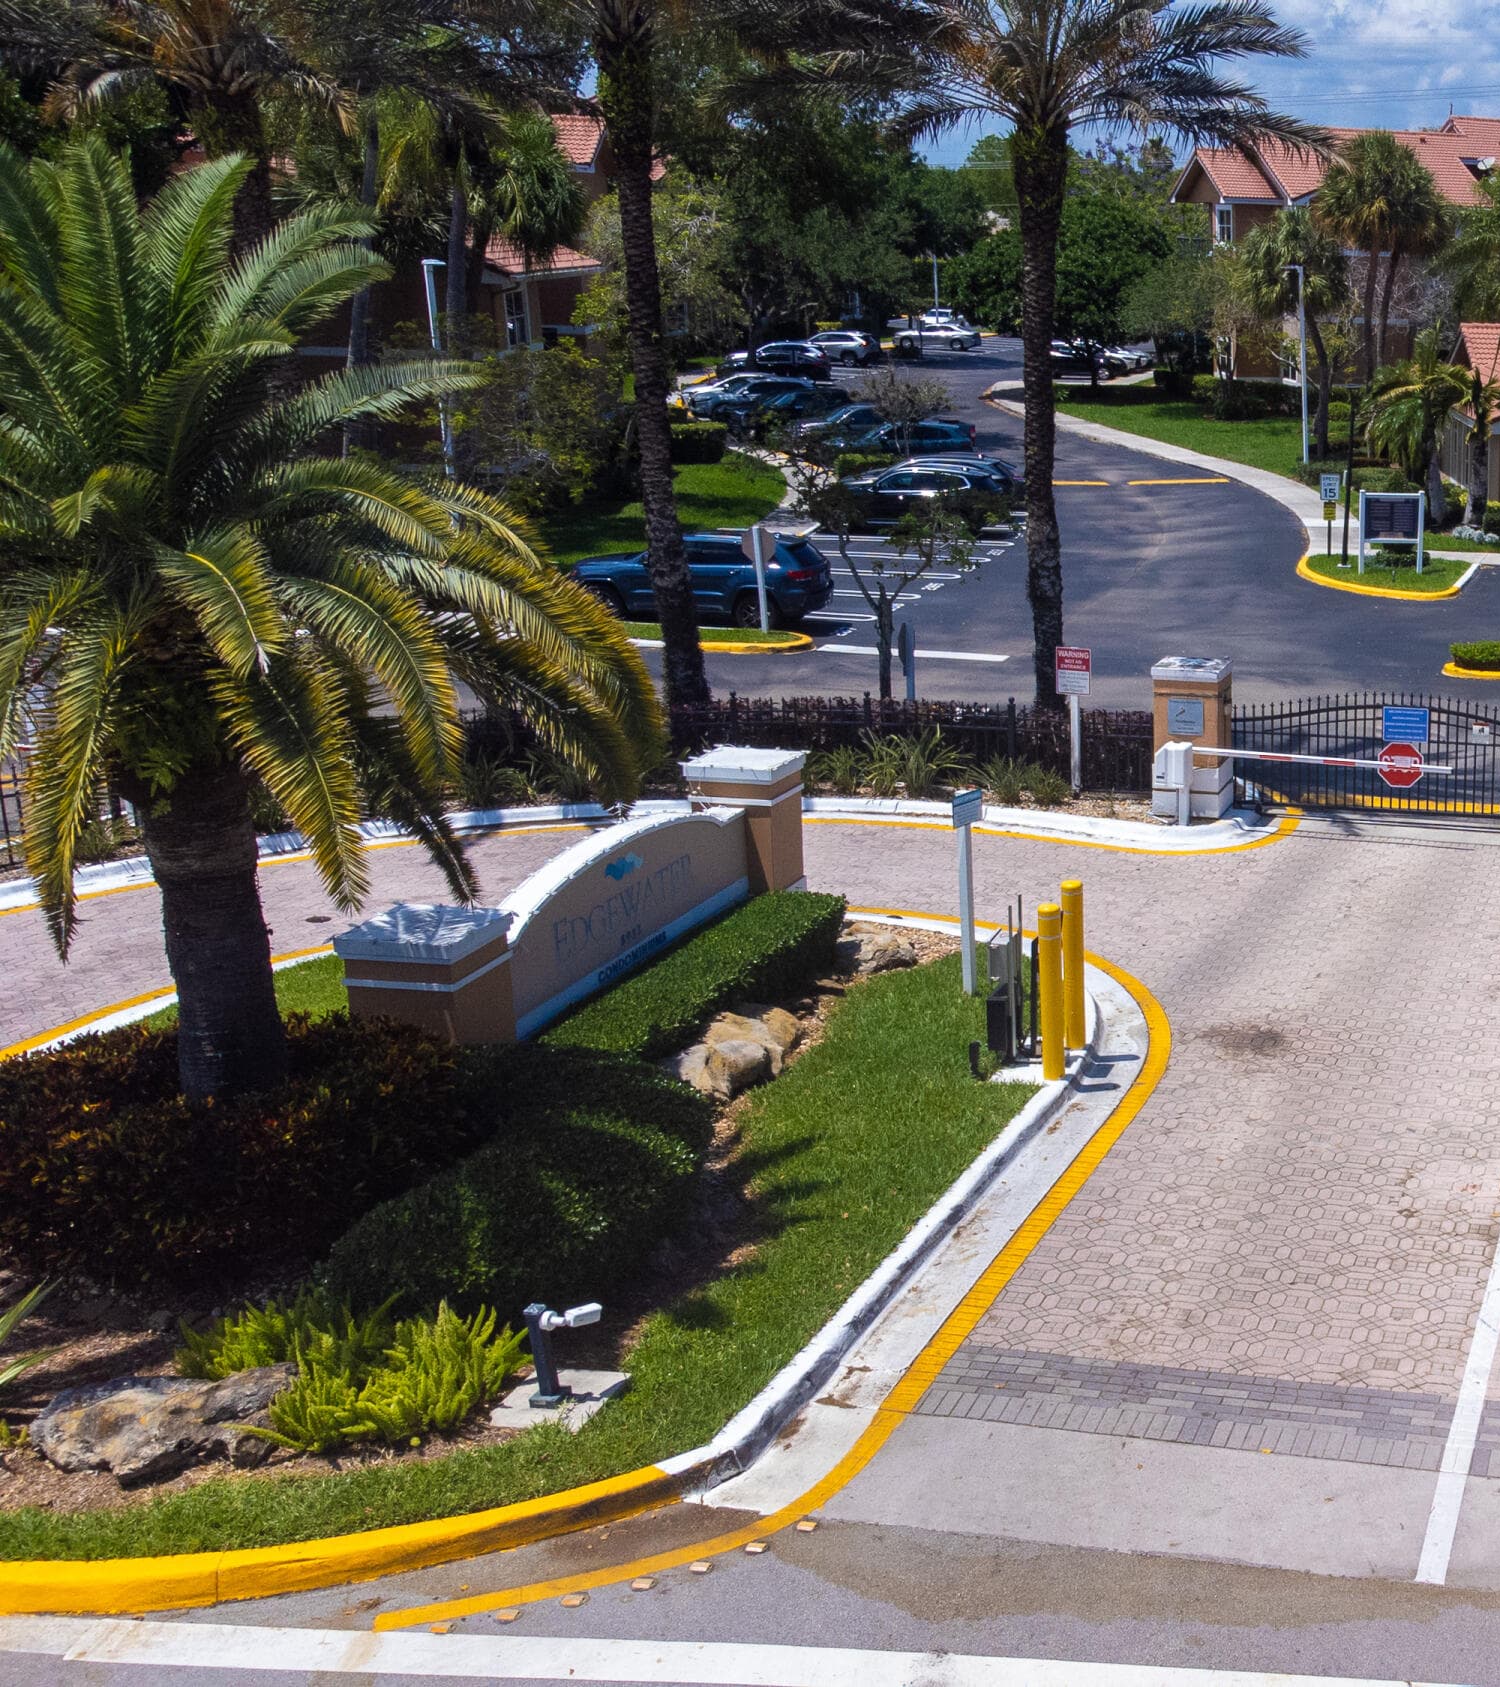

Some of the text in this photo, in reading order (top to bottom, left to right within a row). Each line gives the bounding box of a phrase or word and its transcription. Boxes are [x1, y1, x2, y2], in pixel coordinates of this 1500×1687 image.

[1323, 488, 1336, 498] 15
[1057, 650, 1089, 660] WARNING
[552, 854, 691, 960] EDGEWATER
